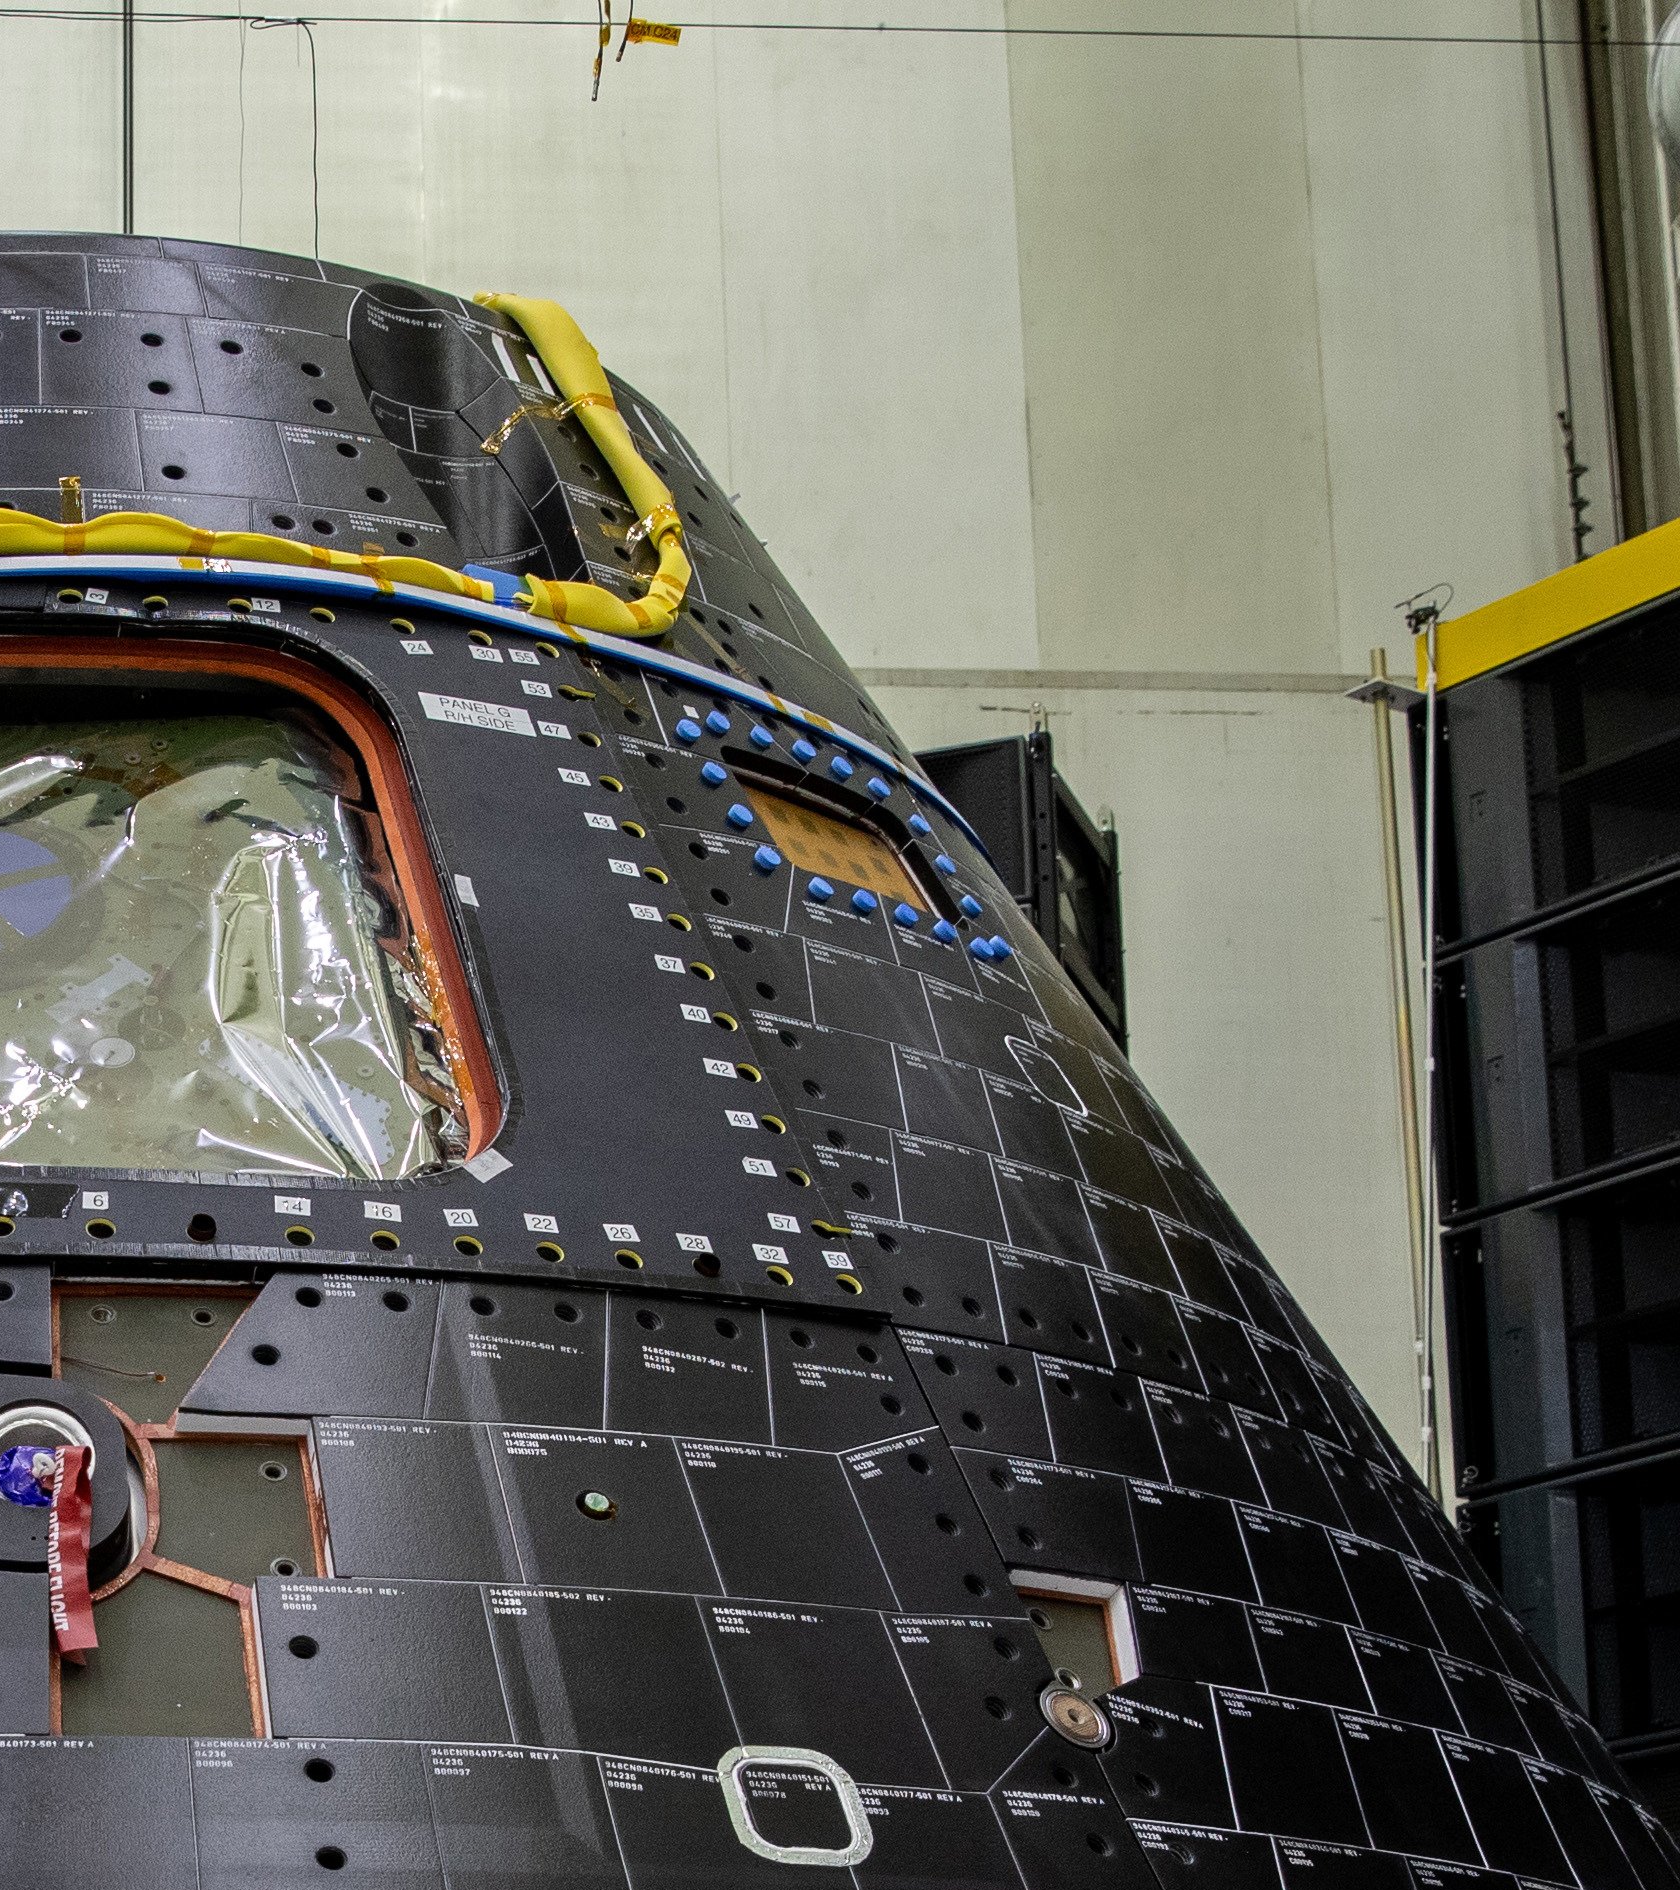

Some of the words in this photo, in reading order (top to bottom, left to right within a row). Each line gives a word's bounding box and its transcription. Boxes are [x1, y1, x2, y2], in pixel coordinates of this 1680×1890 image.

[89, 592, 105, 601] 3
[254, 599, 274, 611] 12
[477, 648, 496, 661] 30
[515, 651, 534, 663] 55
[527, 684, 547, 696] 53
[440, 697, 495, 718] PANEL
[497, 707, 511, 719] G
[444, 710, 475, 725] R/H
[478, 715, 516, 732] SIDE
[543, 724, 561, 736] 47
[566, 771, 584, 784] 45
[591, 816, 610, 828] 43
[613, 862, 634, 875] 39
[636, 907, 655, 919] 35
[659, 957, 678, 970] 37
[687, 1007, 707, 1021] 40
[710, 1061, 731, 1075] 42
[733, 1113, 752, 1126] 49
[748, 1160, 768, 1174] 51
[92, 1195, 104, 1207] 6
[449, 1211, 472, 1226] 20
[531, 1216, 553, 1231] 22
[773, 1216, 791, 1229] 57
[609, 1225, 632, 1240] 26
[683, 1236, 705, 1250] 28
[759, 1247, 779, 1261] 32
[827, 1254, 847, 1267] 59
[614, 1438, 633, 1446] REV
[379, 1588, 398, 1596] REV
[586, 1593, 604, 1602] REV
[63, 1741, 83, 1749] REV
[529, 1752, 549, 1760] REV
